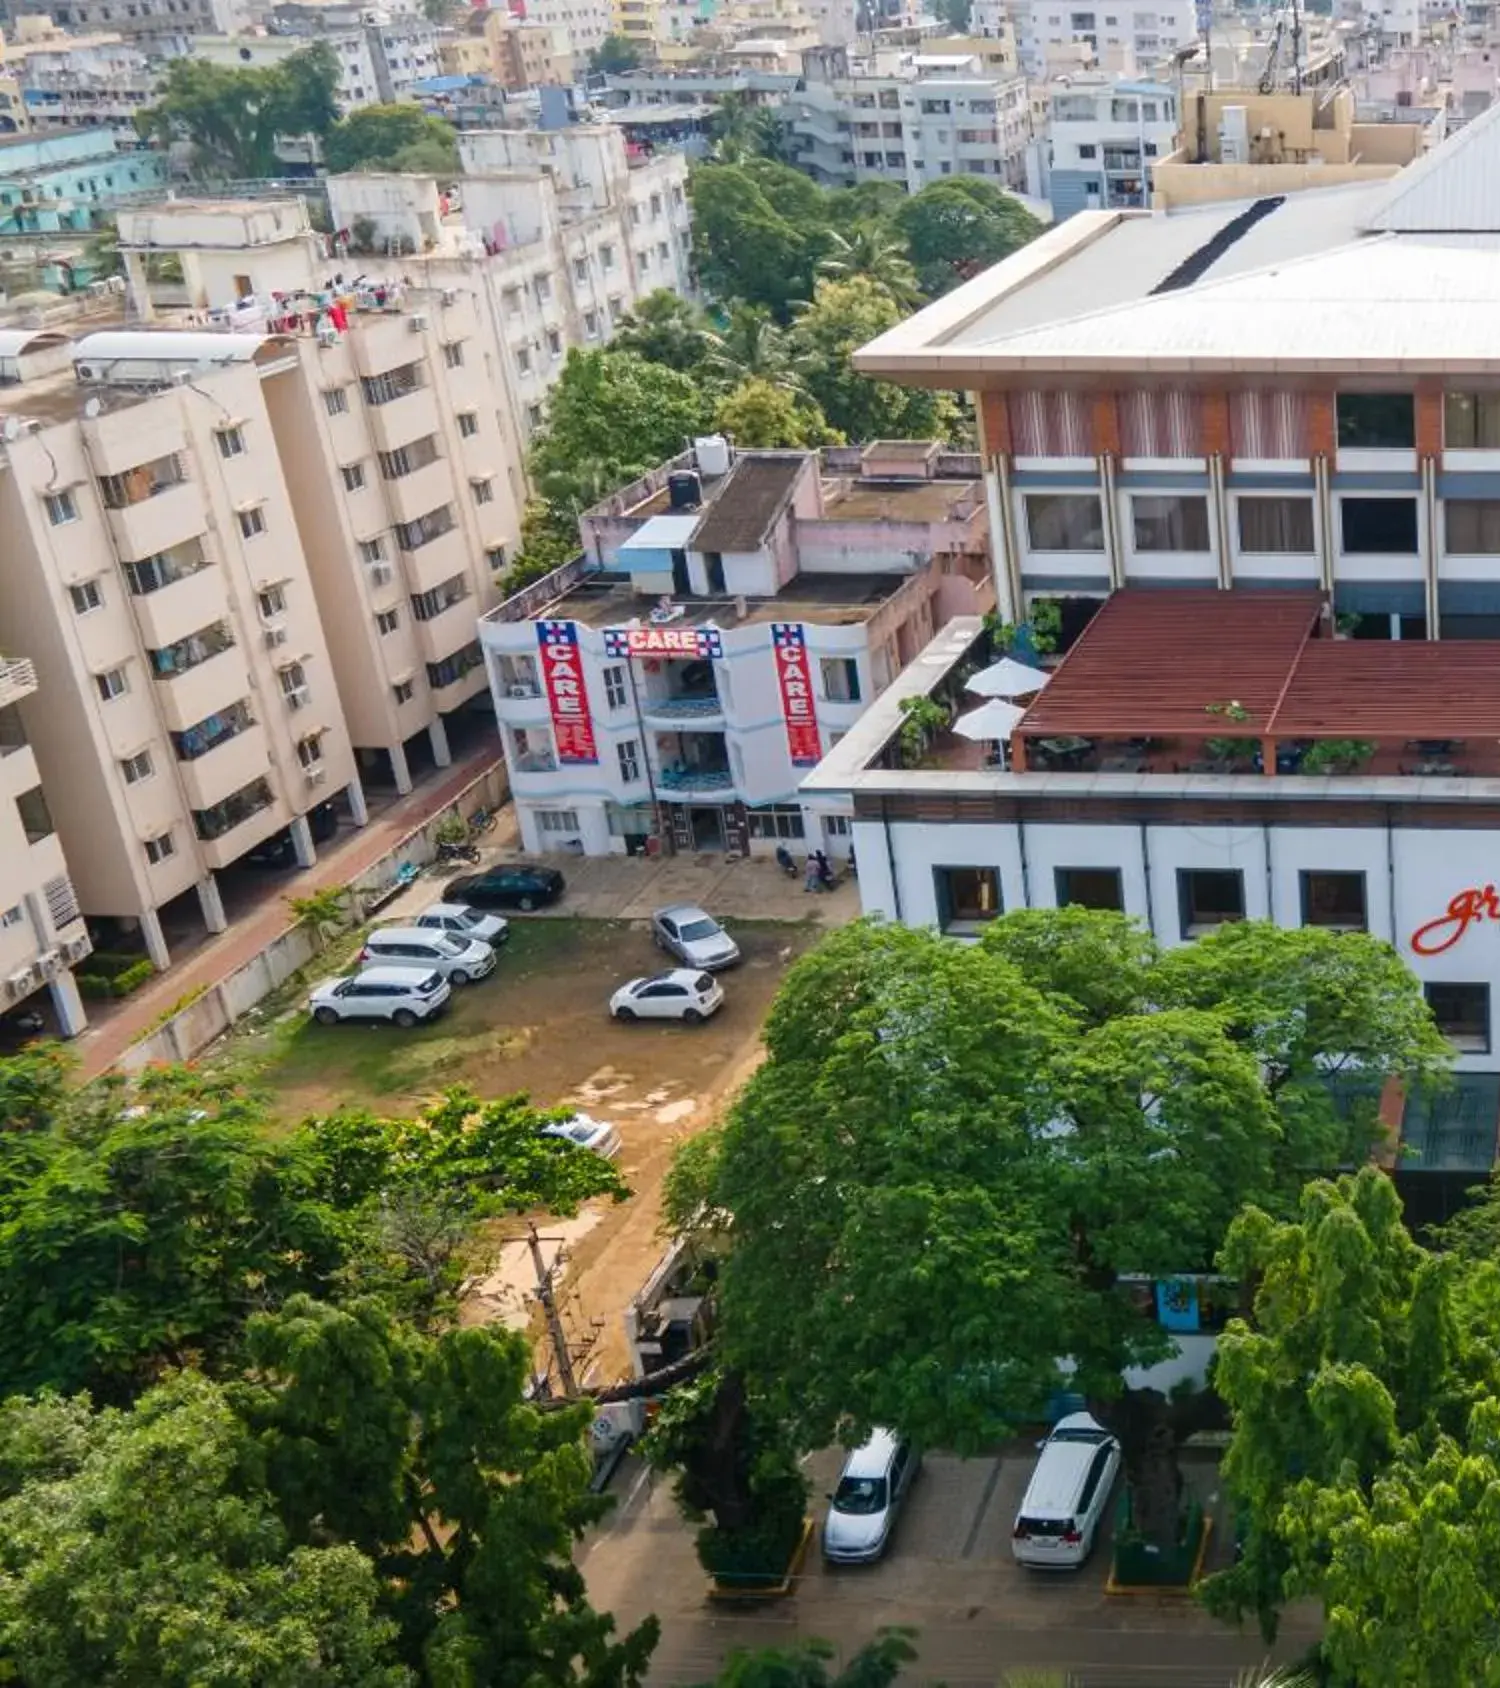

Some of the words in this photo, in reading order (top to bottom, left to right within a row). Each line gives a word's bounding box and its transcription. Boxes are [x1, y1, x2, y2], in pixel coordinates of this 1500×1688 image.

[628, 631, 697, 649] CARE
[547, 645, 582, 713] CARE
[781, 647, 808, 714] CARE
